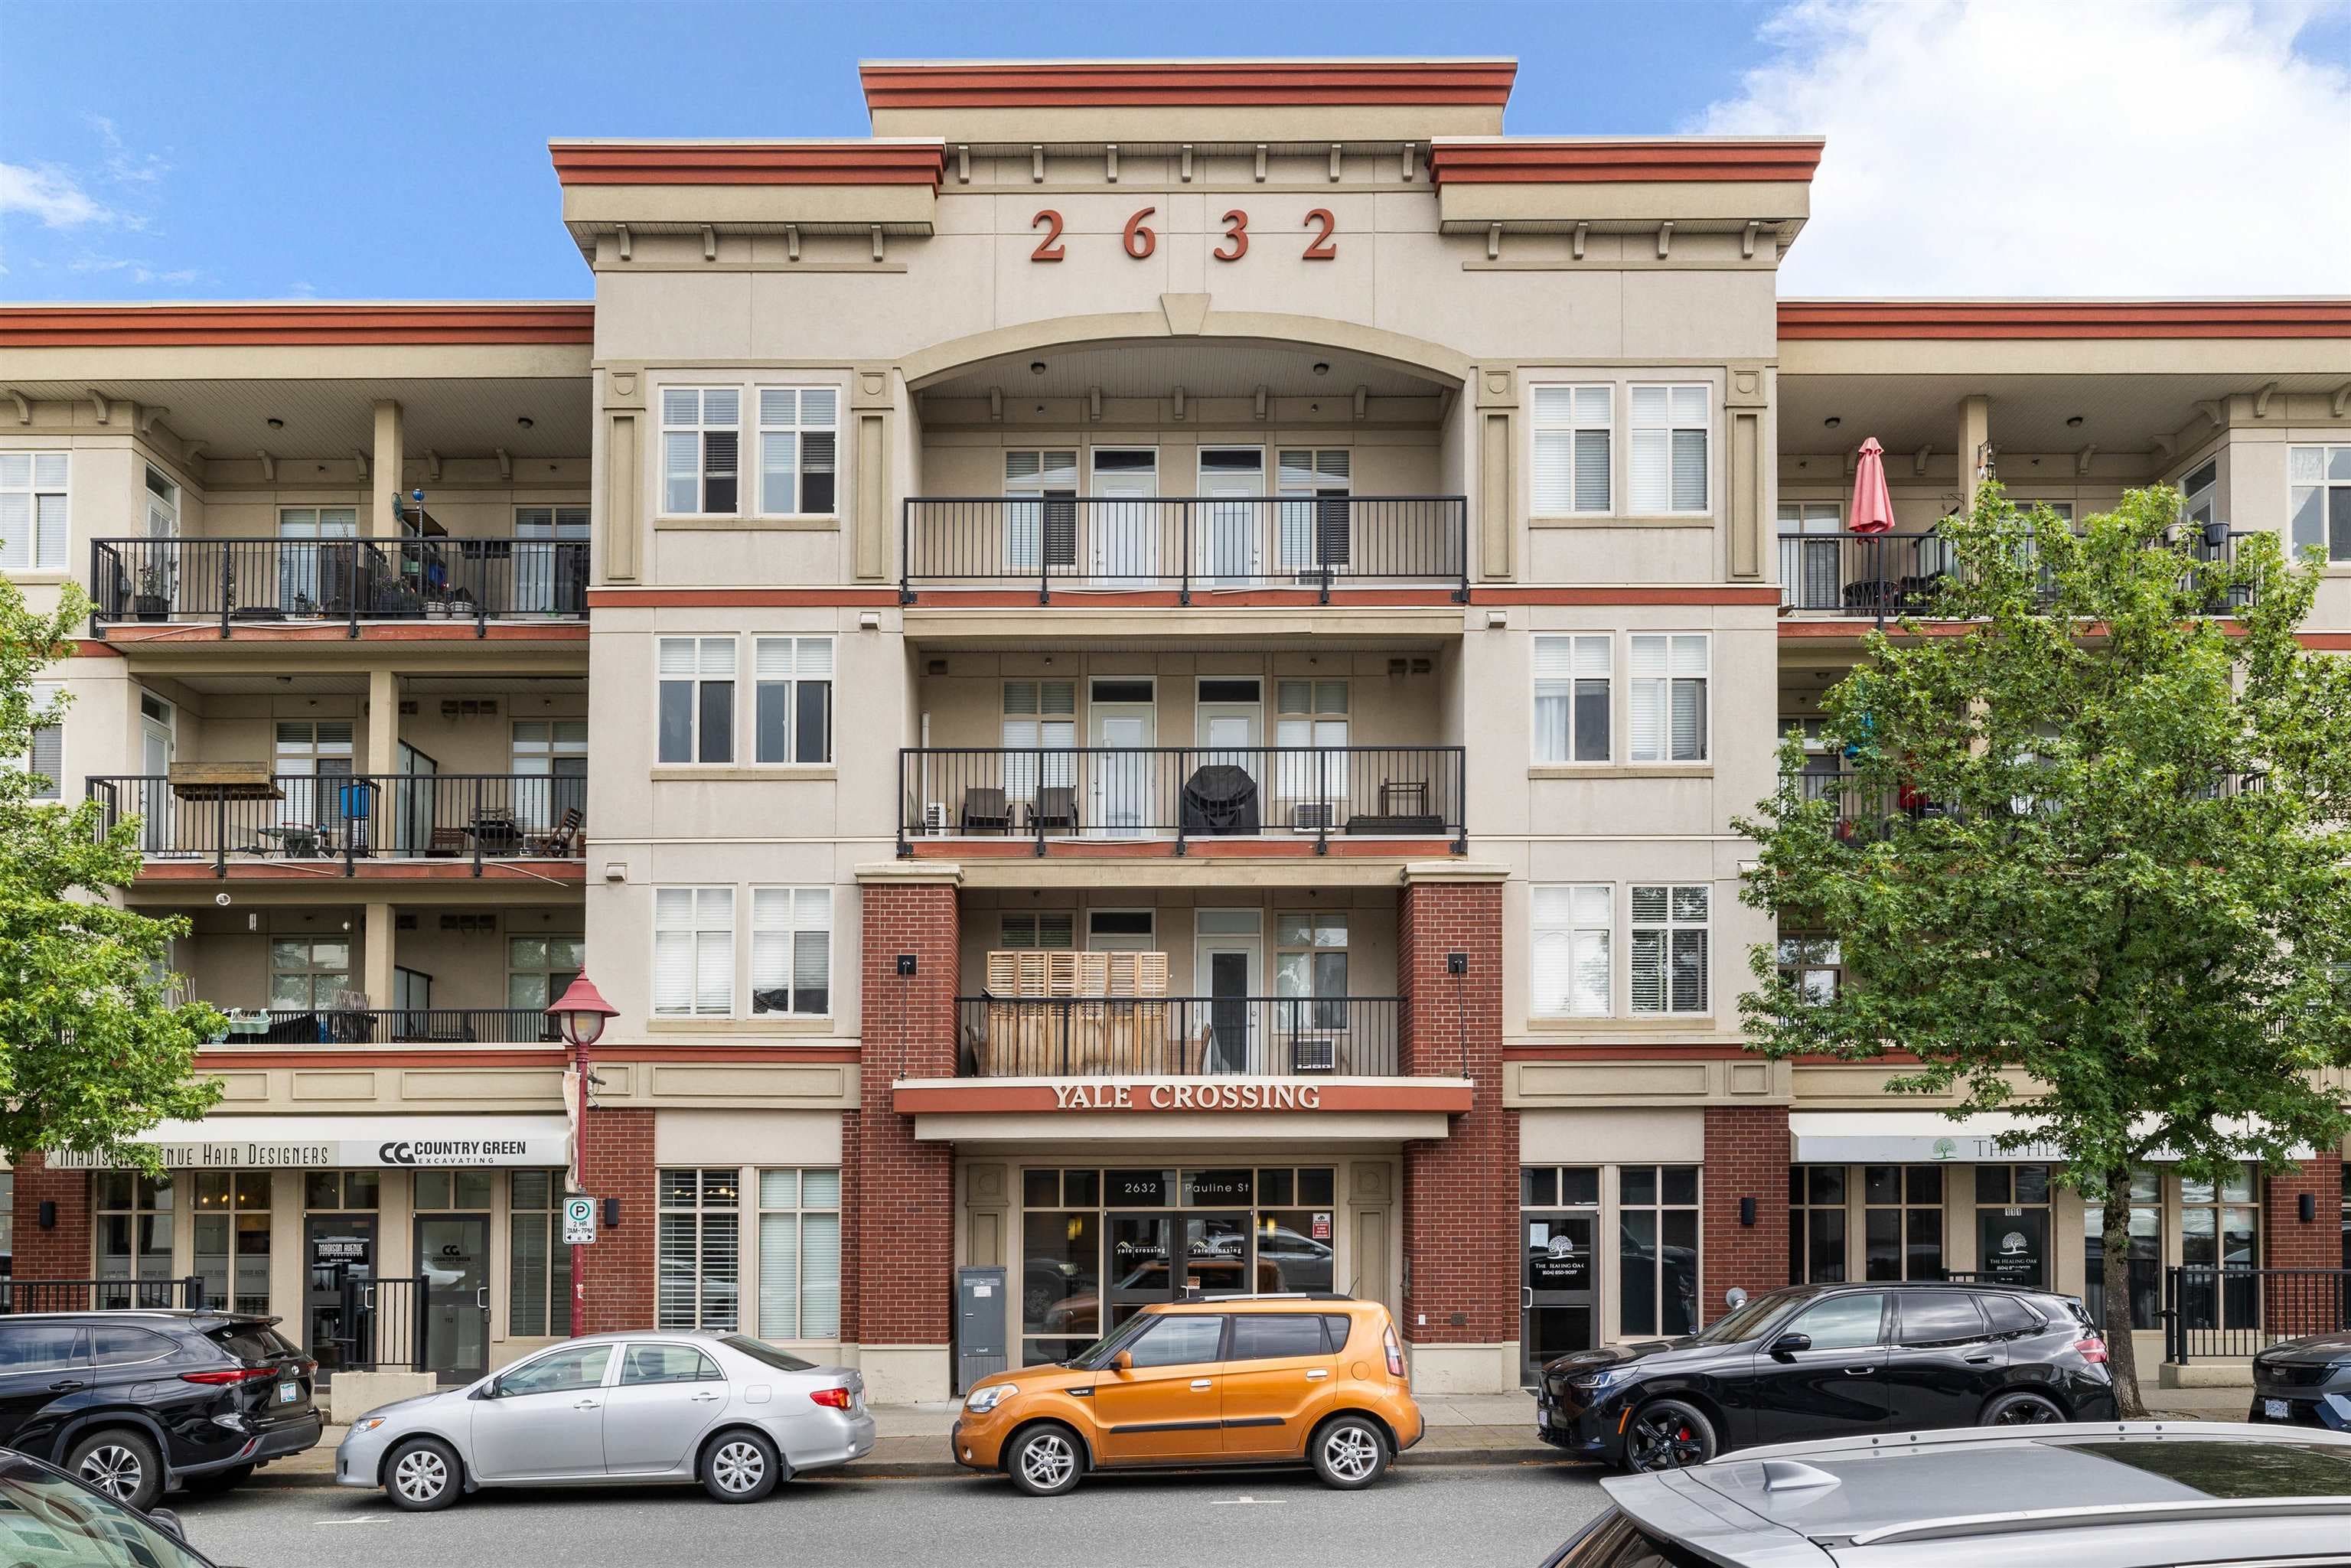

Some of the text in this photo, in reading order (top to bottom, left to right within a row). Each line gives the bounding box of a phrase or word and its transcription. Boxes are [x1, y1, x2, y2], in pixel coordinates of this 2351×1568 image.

[1052, 1085, 1320, 1109] YALE CROSSING
[414, 1141, 527, 1155] COUNTRY GREEN
[60, 1143, 129, 1166] MADISO
[204, 1143, 238, 1165] HAIR
[249, 1143, 329, 1165] DESIGNERS
[1125, 1183, 1249, 1193] 2632 Pauline St
[318, 1244, 364, 1253] MADISON AVENUE
[1135, 1246, 1166, 1254] crossing
[1211, 1246, 1242, 1254] crossing
